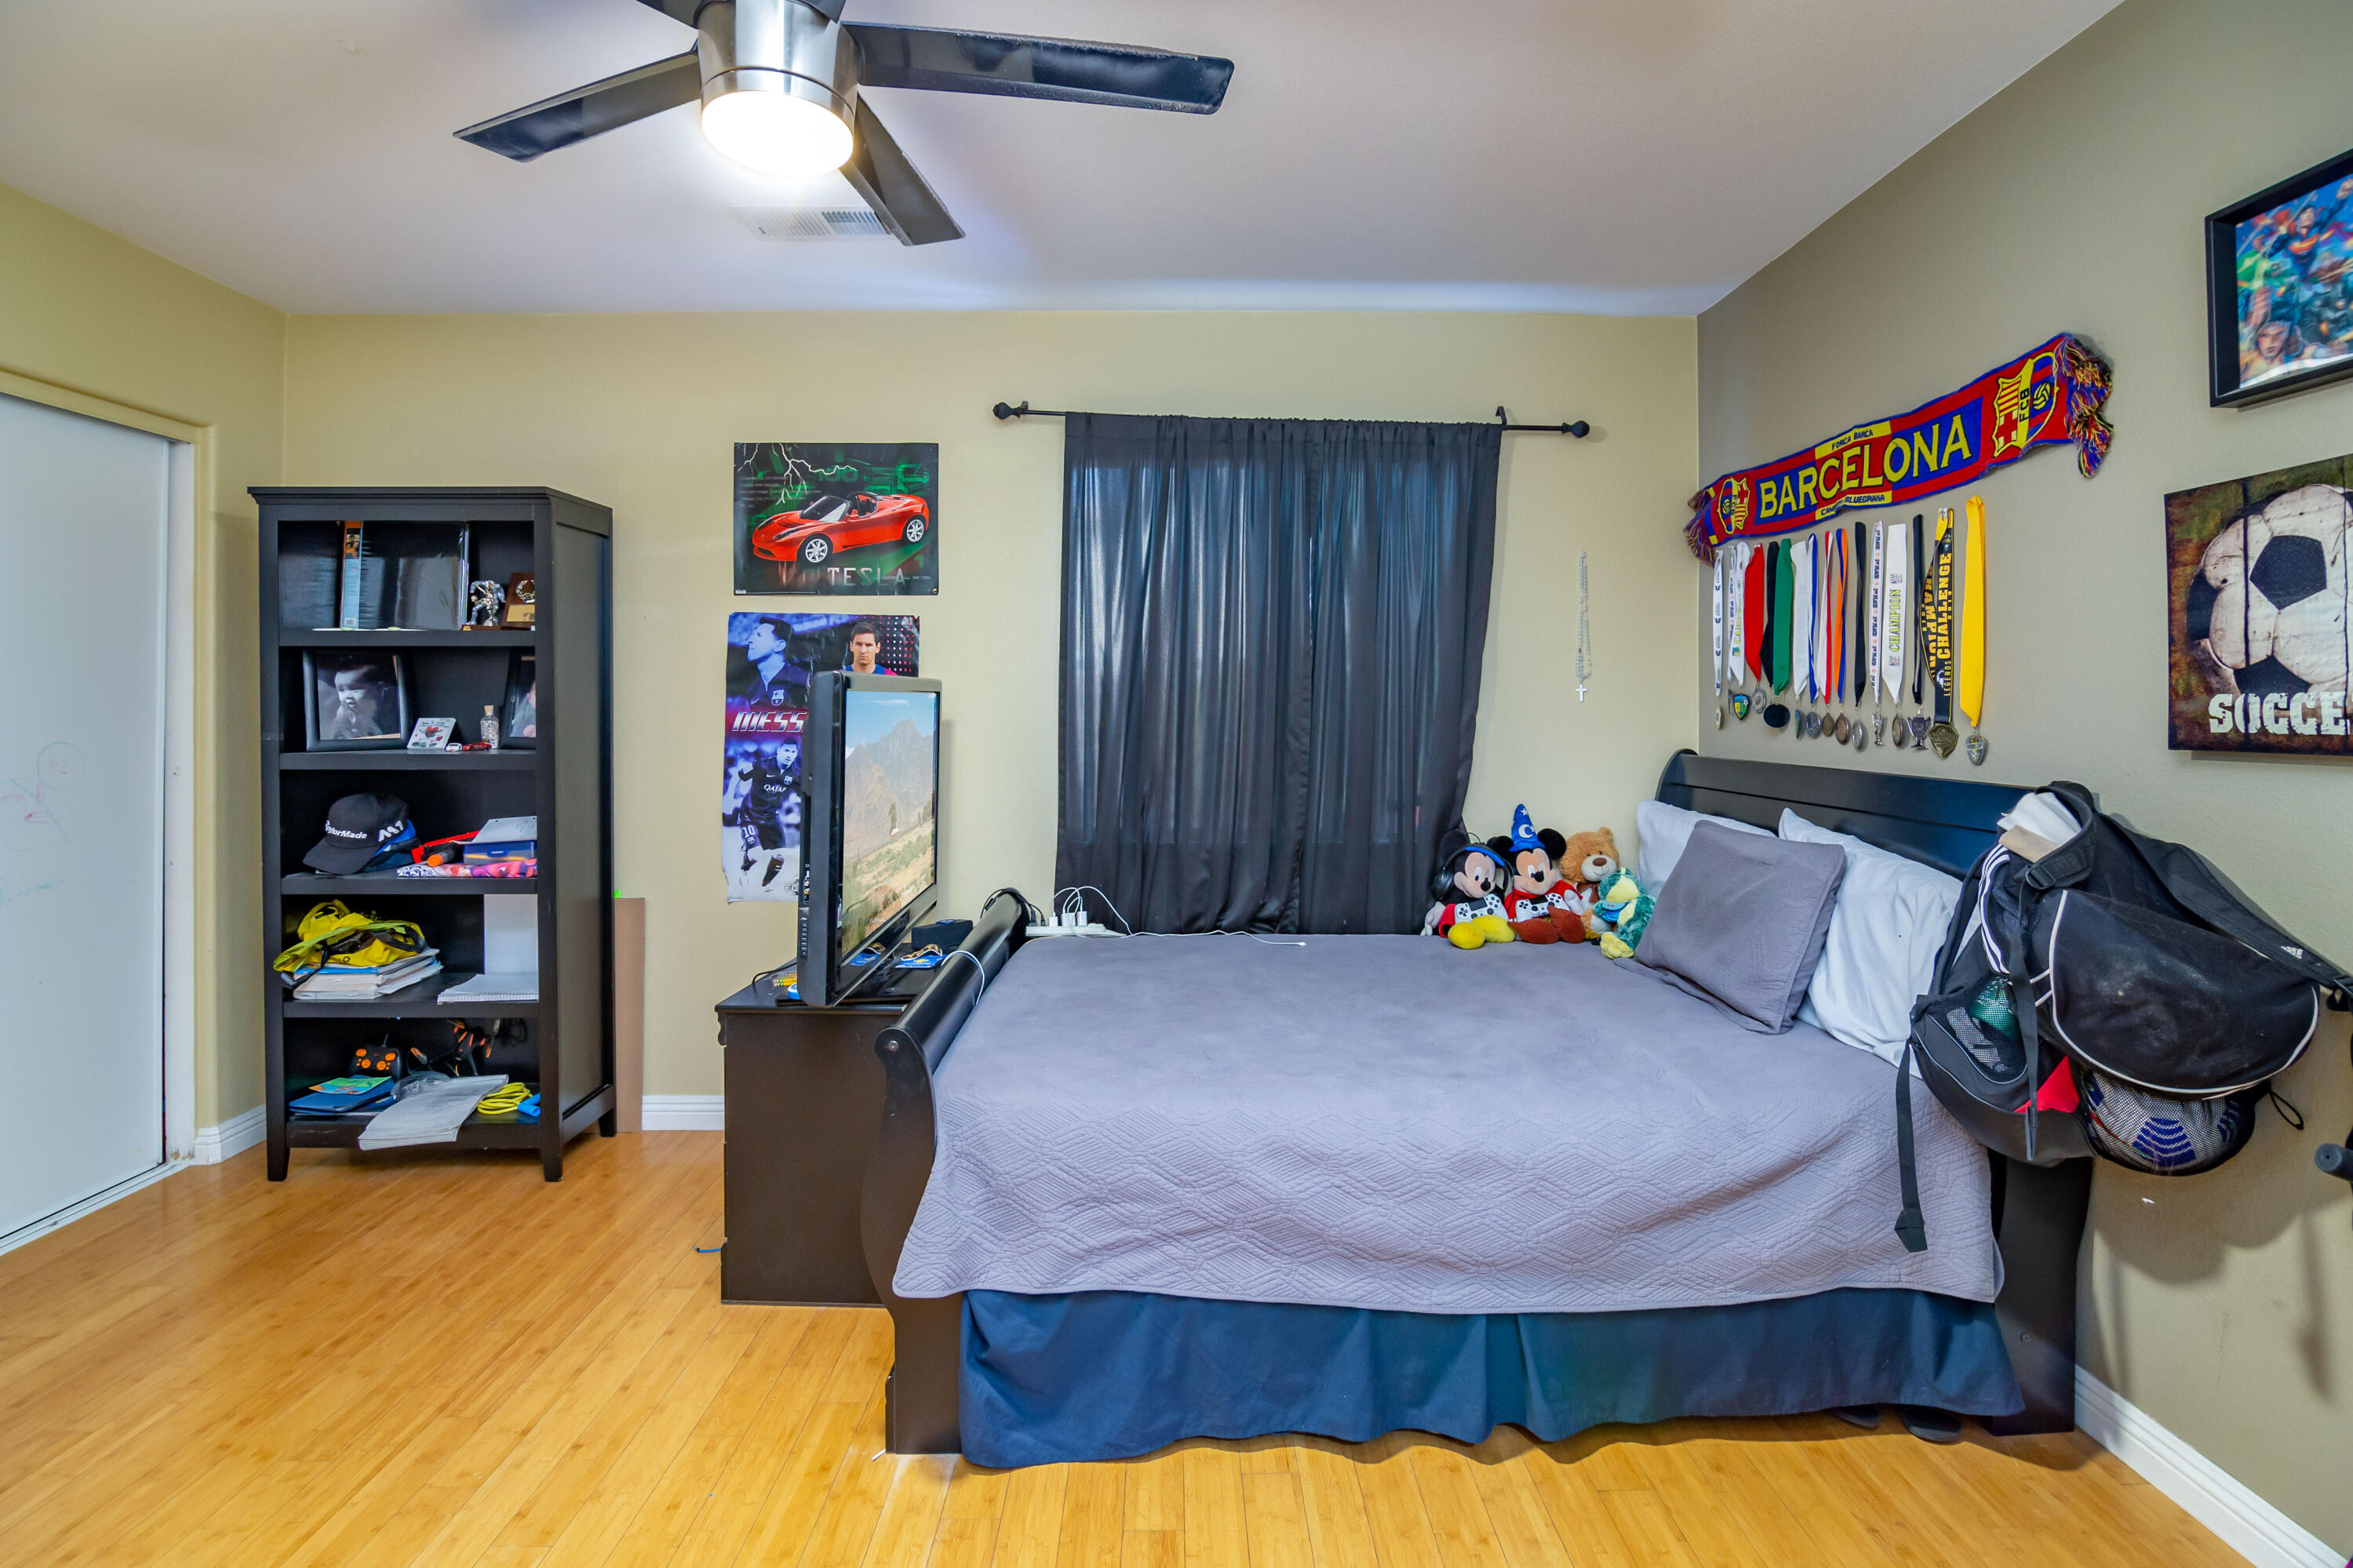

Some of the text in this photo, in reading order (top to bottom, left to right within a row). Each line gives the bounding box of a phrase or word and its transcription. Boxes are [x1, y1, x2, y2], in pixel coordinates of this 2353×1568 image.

[2019, 387, 2030, 422] FCB
[1759, 414, 1972, 518] BARCELONA
[1845, 493, 1885, 504] BLUEGRANA
[827, 567, 905, 587] TESLA
[1889, 589, 1902, 652] CHAMPION
[1924, 565, 1937, 668] CHAMPION
[1937, 552, 1952, 659] CHALLENGE
[1943, 660, 1952, 697] LEGENDS
[731, 711, 808, 733] MESS
[2209, 692, 2353, 735] SOCCE
[742, 825, 756, 835] 10
